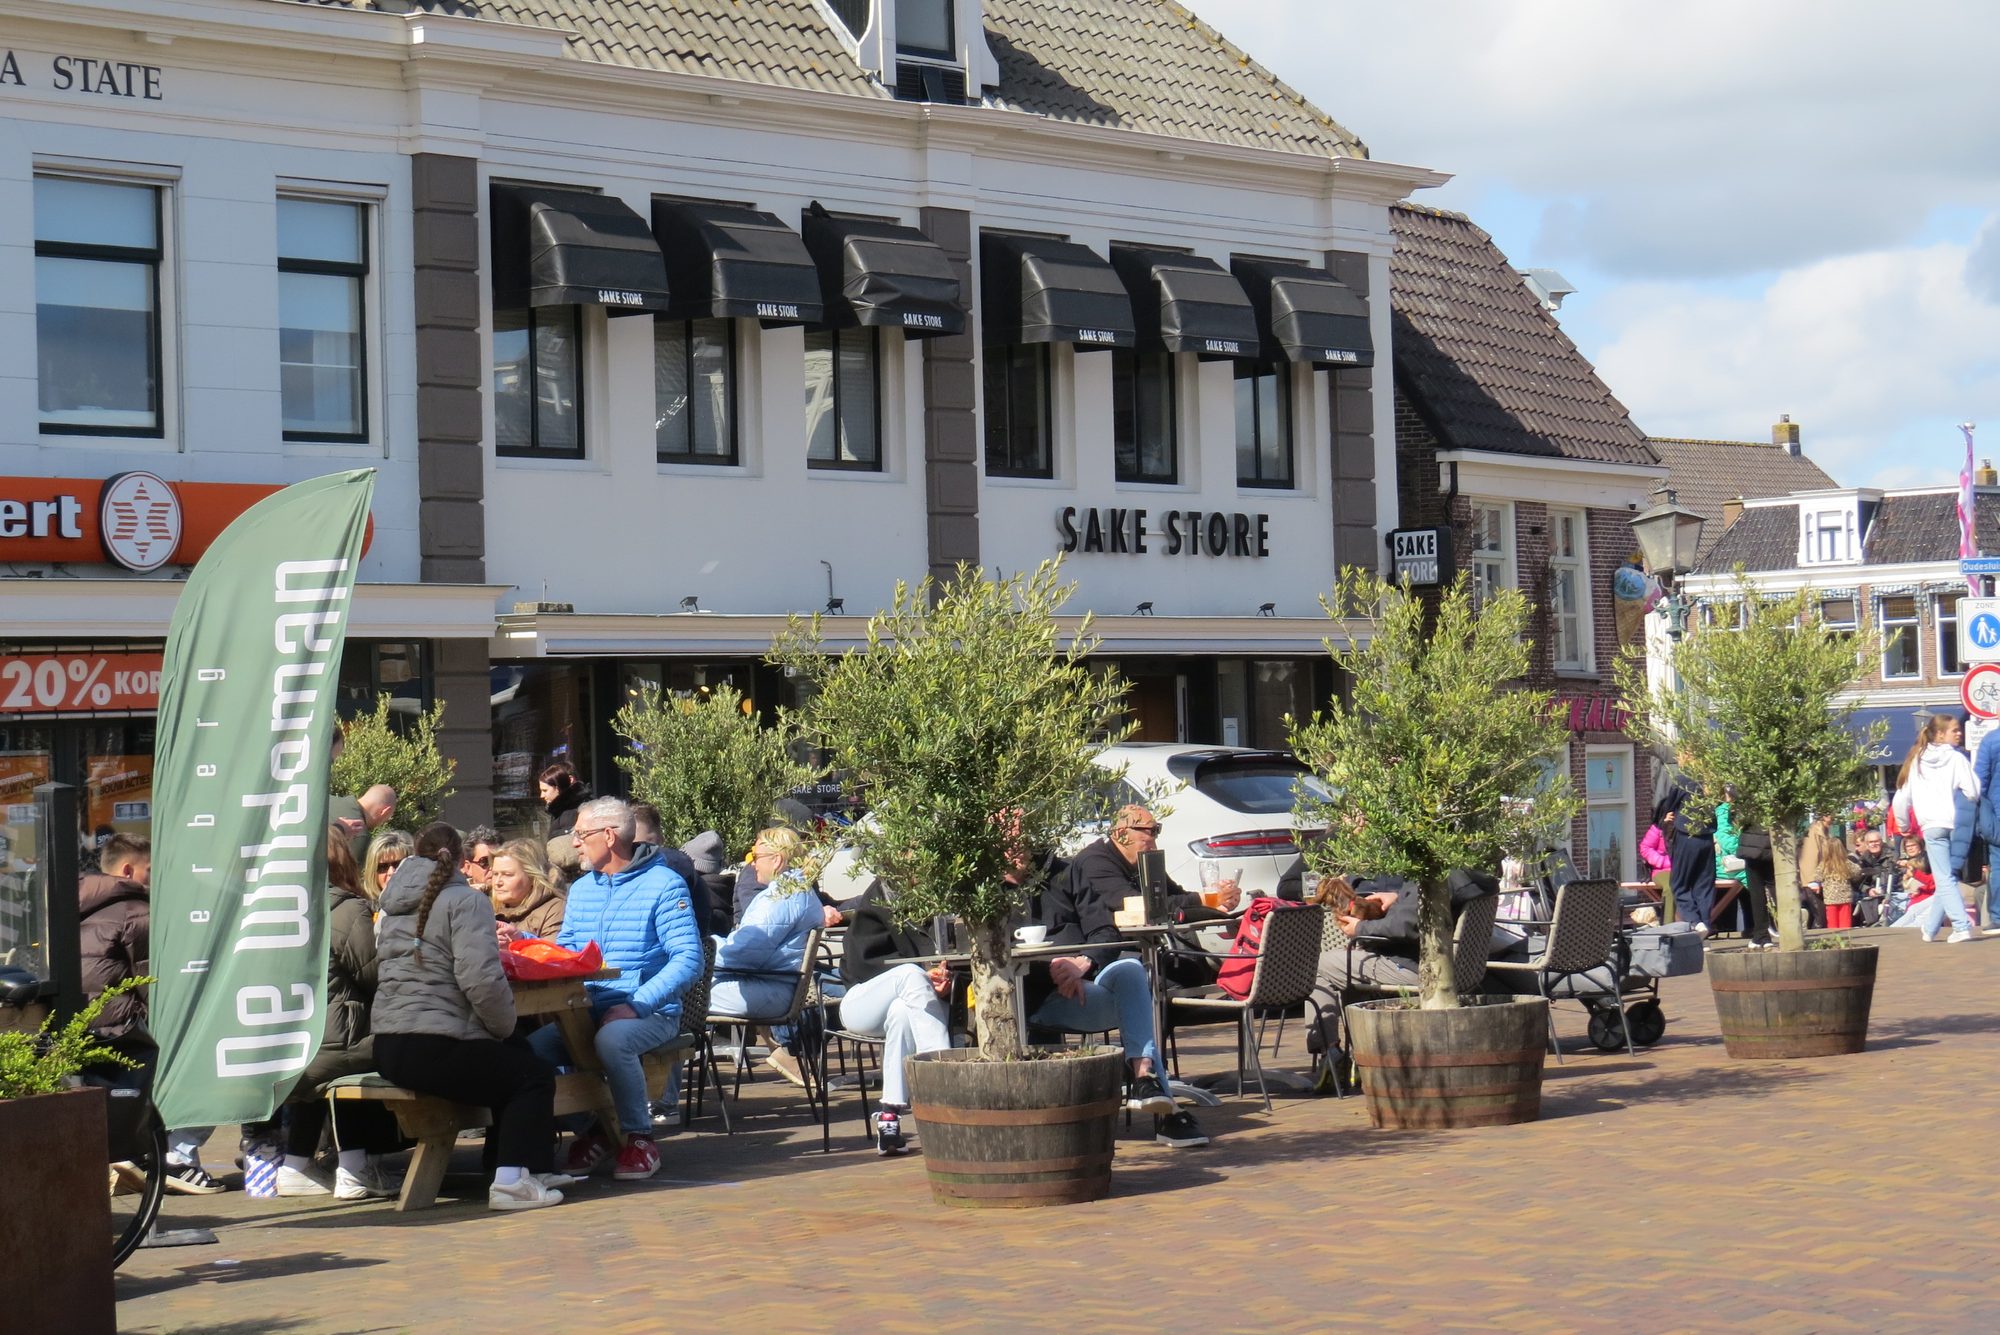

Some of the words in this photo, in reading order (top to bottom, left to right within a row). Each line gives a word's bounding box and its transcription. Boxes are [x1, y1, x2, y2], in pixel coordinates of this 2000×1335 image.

[52, 55, 163, 101] STATE
[598, 290, 621, 304] SAKE
[621, 292, 644, 306] STORE
[756, 303, 778, 316] SAKE
[778, 305, 799, 318] STORE
[903, 312, 923, 326] SAKE
[923, 314, 943, 328] STORE
[1079, 329, 1098, 341] SAKE
[1097, 331, 1115, 343] STORE
[1205, 339, 1223, 351] SAKE
[1223, 341, 1239, 353] STORE
[1325, 349, 1342, 361] SAKE
[1057, 506, 1147, 554] SAKE
[1161, 510, 1269, 557] STORE
[1396, 534, 1434, 557] SAKE
[1398, 561, 1436, 582] STORE
[1, 658, 112, 708] 20%
[233, 558, 348, 954] Wildeman
[791, 785, 812, 794] SAKE
[816, 784, 841, 794] STORE
[180, 668, 226, 974] herberg
[216, 982, 315, 1078] De
